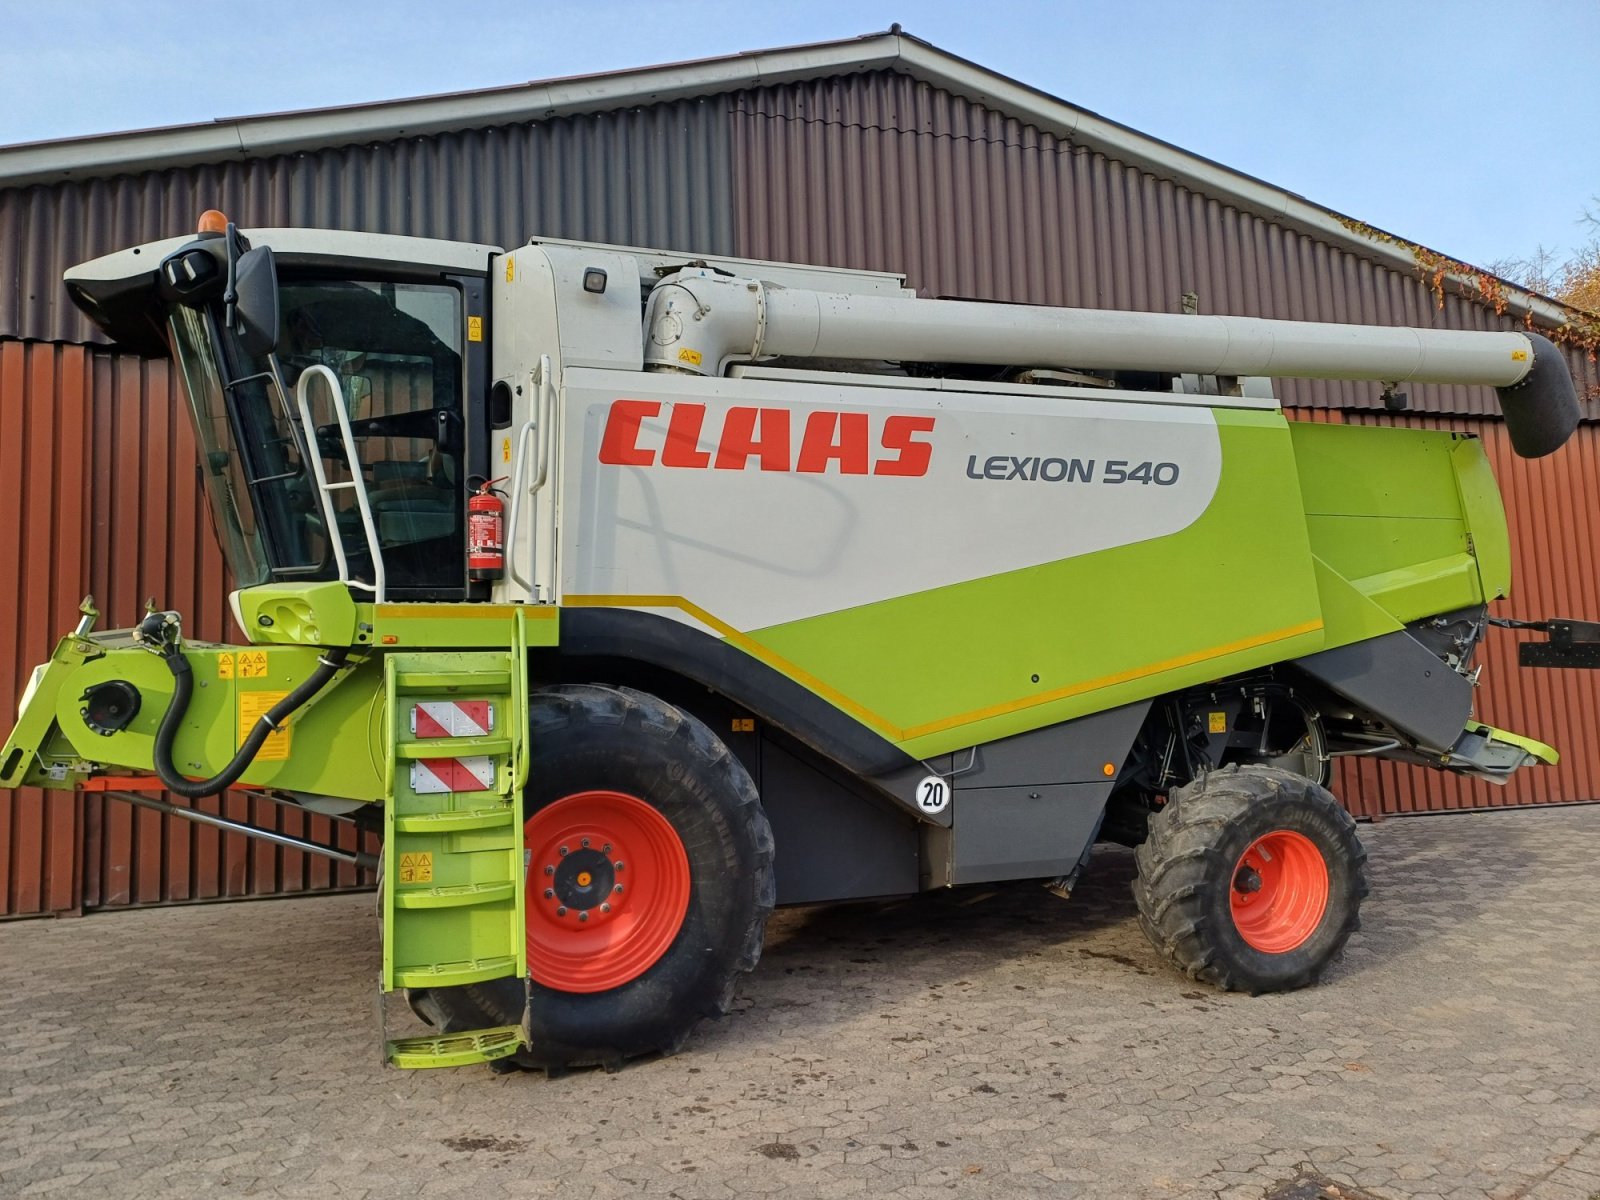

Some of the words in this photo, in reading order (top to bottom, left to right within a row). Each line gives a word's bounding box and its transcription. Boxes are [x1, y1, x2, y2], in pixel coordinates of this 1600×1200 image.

[598, 400, 935, 477] CLAAS
[966, 455, 1095, 484] LEXION
[1102, 461, 1180, 486] 540
[923, 782, 943, 806] 20
